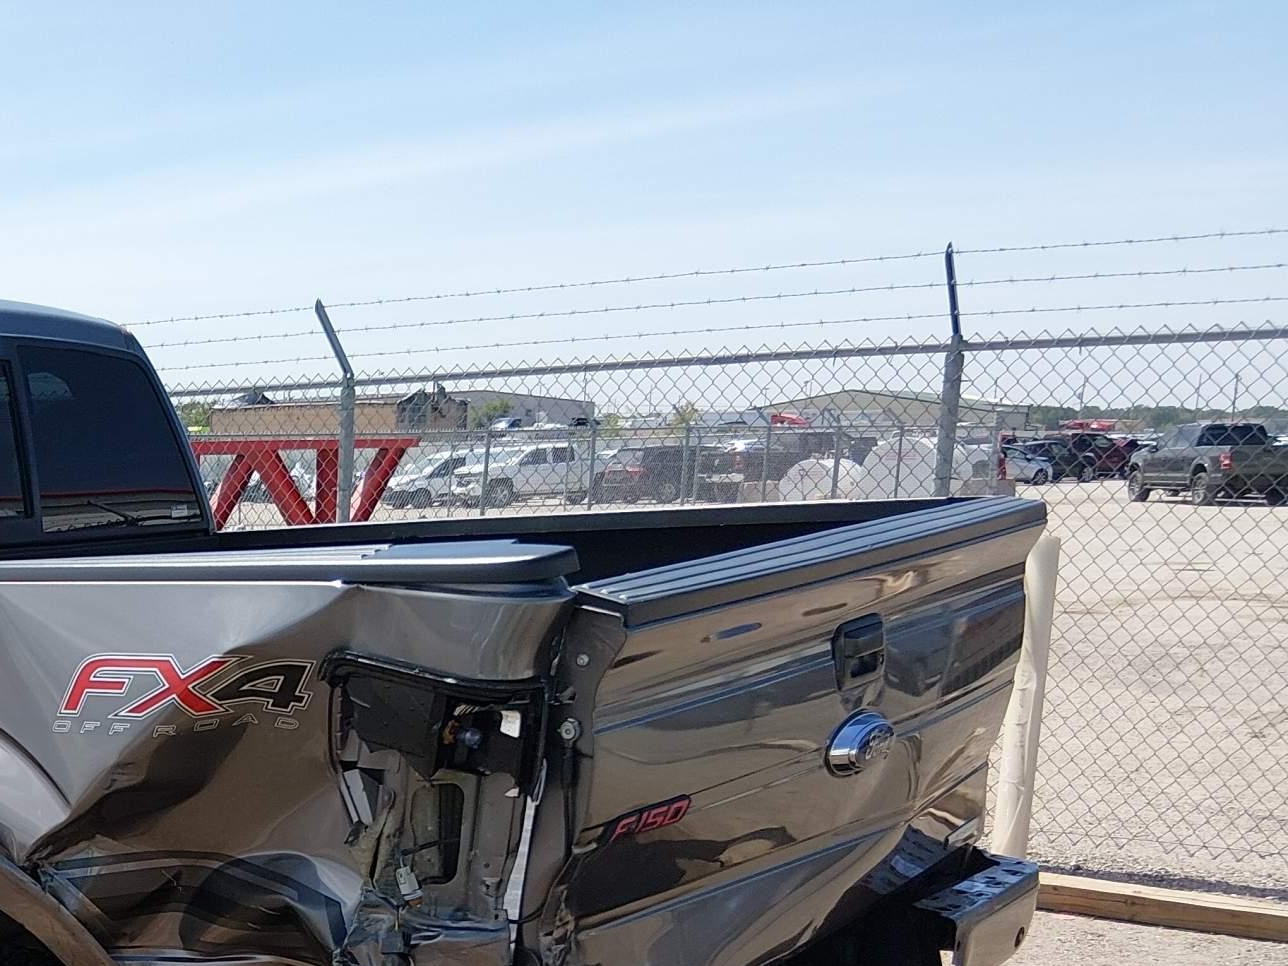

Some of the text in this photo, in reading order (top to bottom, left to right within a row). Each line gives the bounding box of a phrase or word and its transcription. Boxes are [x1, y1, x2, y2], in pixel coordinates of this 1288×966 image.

[57, 652, 316, 720] FX4
[52, 713, 300, 738] OFF ROAD
